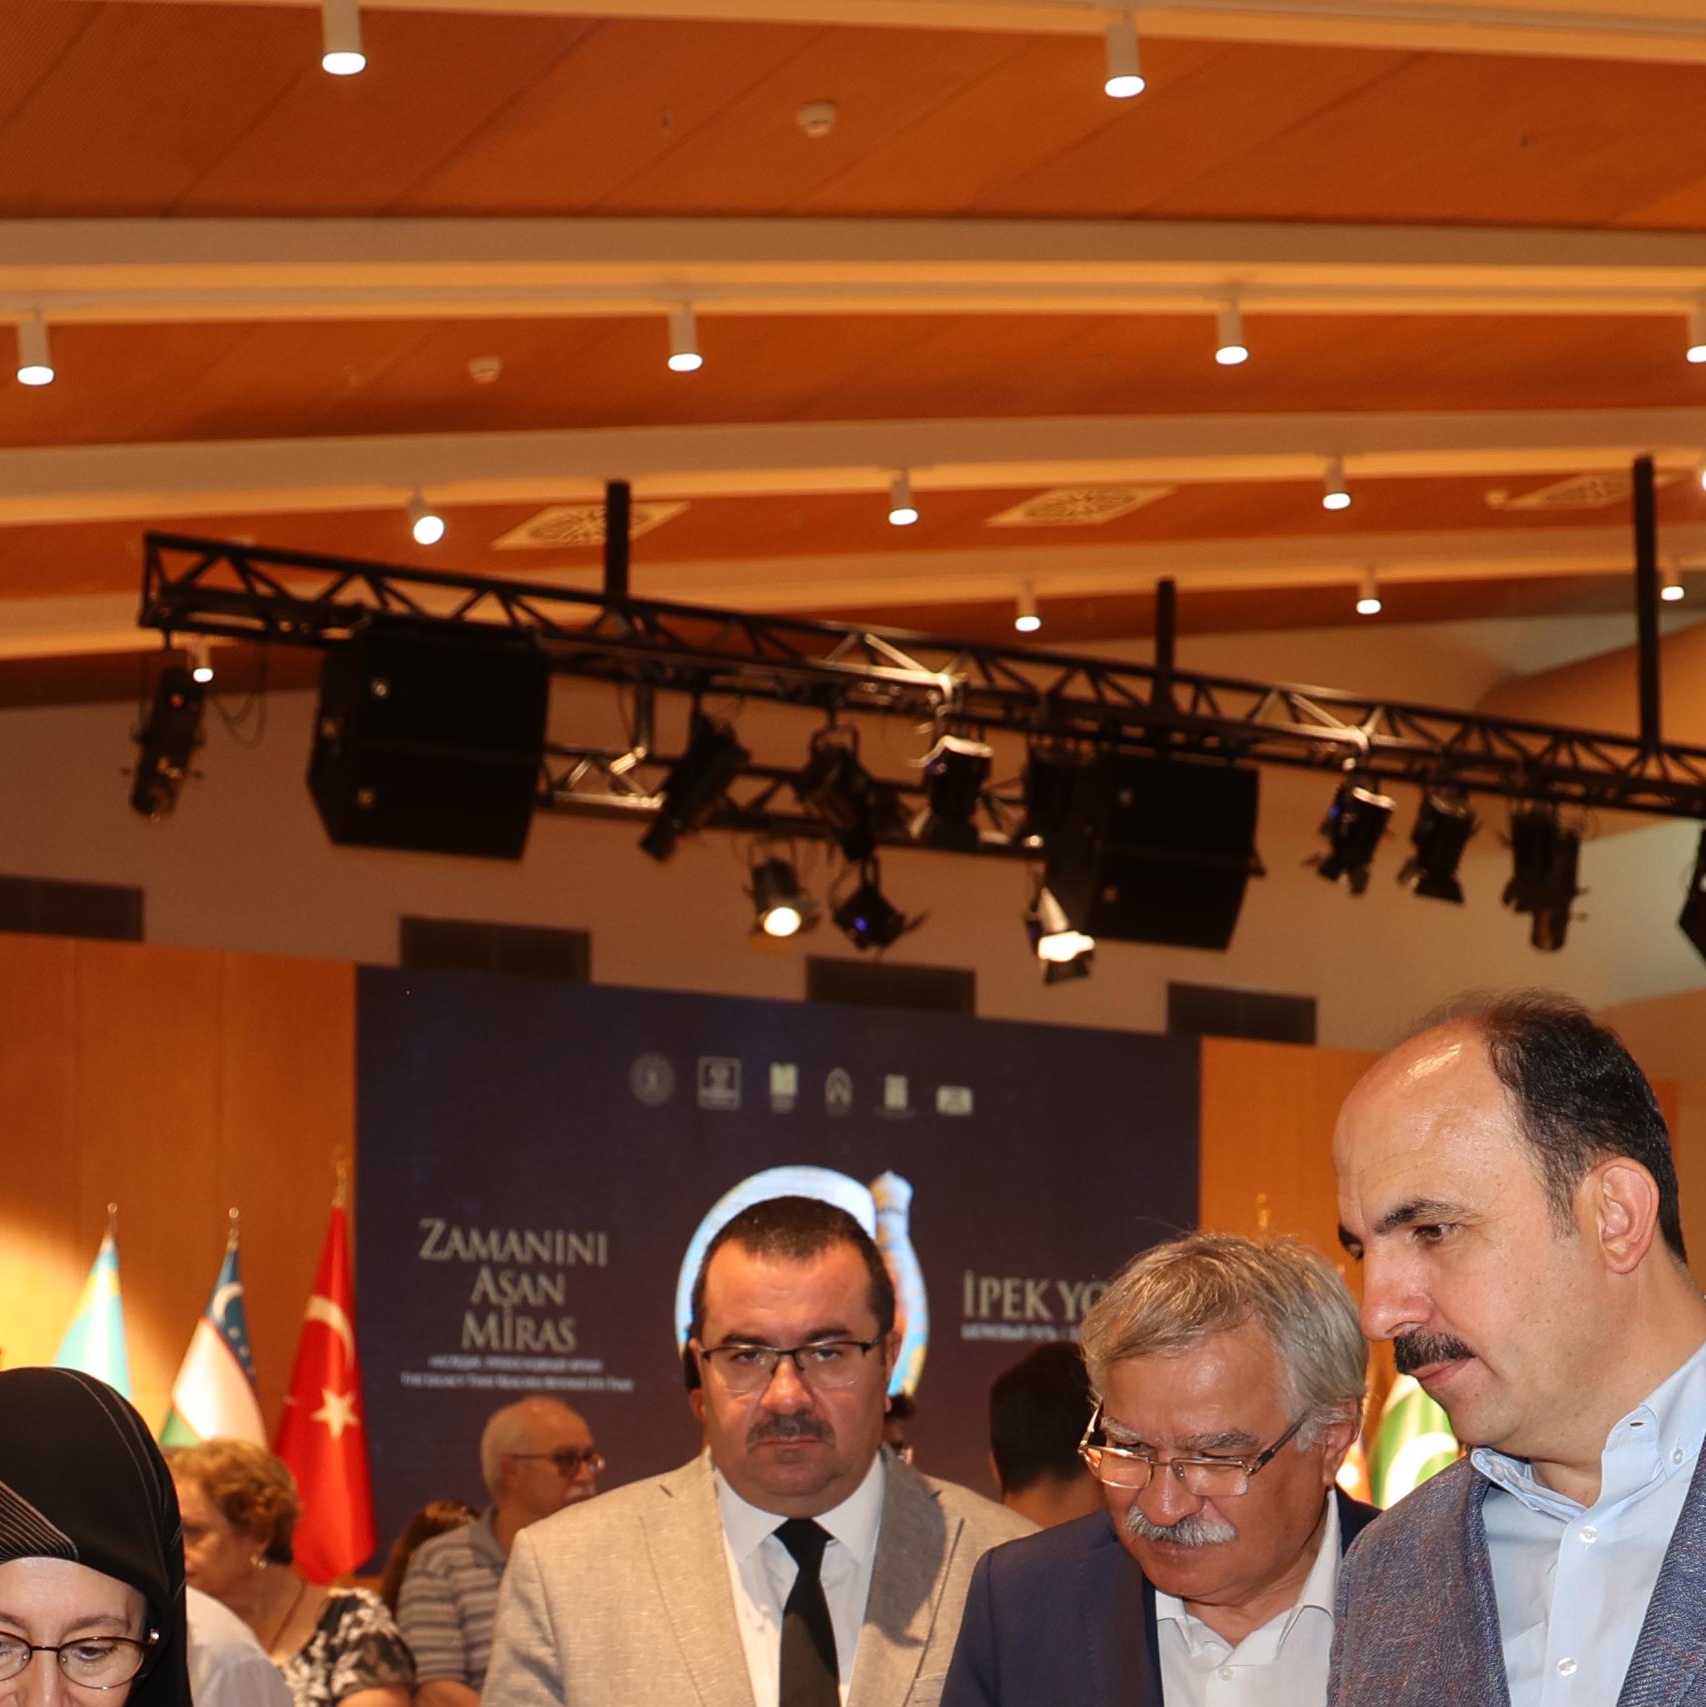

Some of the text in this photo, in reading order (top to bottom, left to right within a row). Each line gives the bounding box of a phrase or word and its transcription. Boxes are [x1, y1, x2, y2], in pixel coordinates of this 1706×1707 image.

[418, 1217, 609, 1267] ZAMANINI
[470, 1265, 567, 1307] AŞAN
[963, 1268, 1054, 1321] İPEK
[461, 1303, 577, 1353] MİRAS
